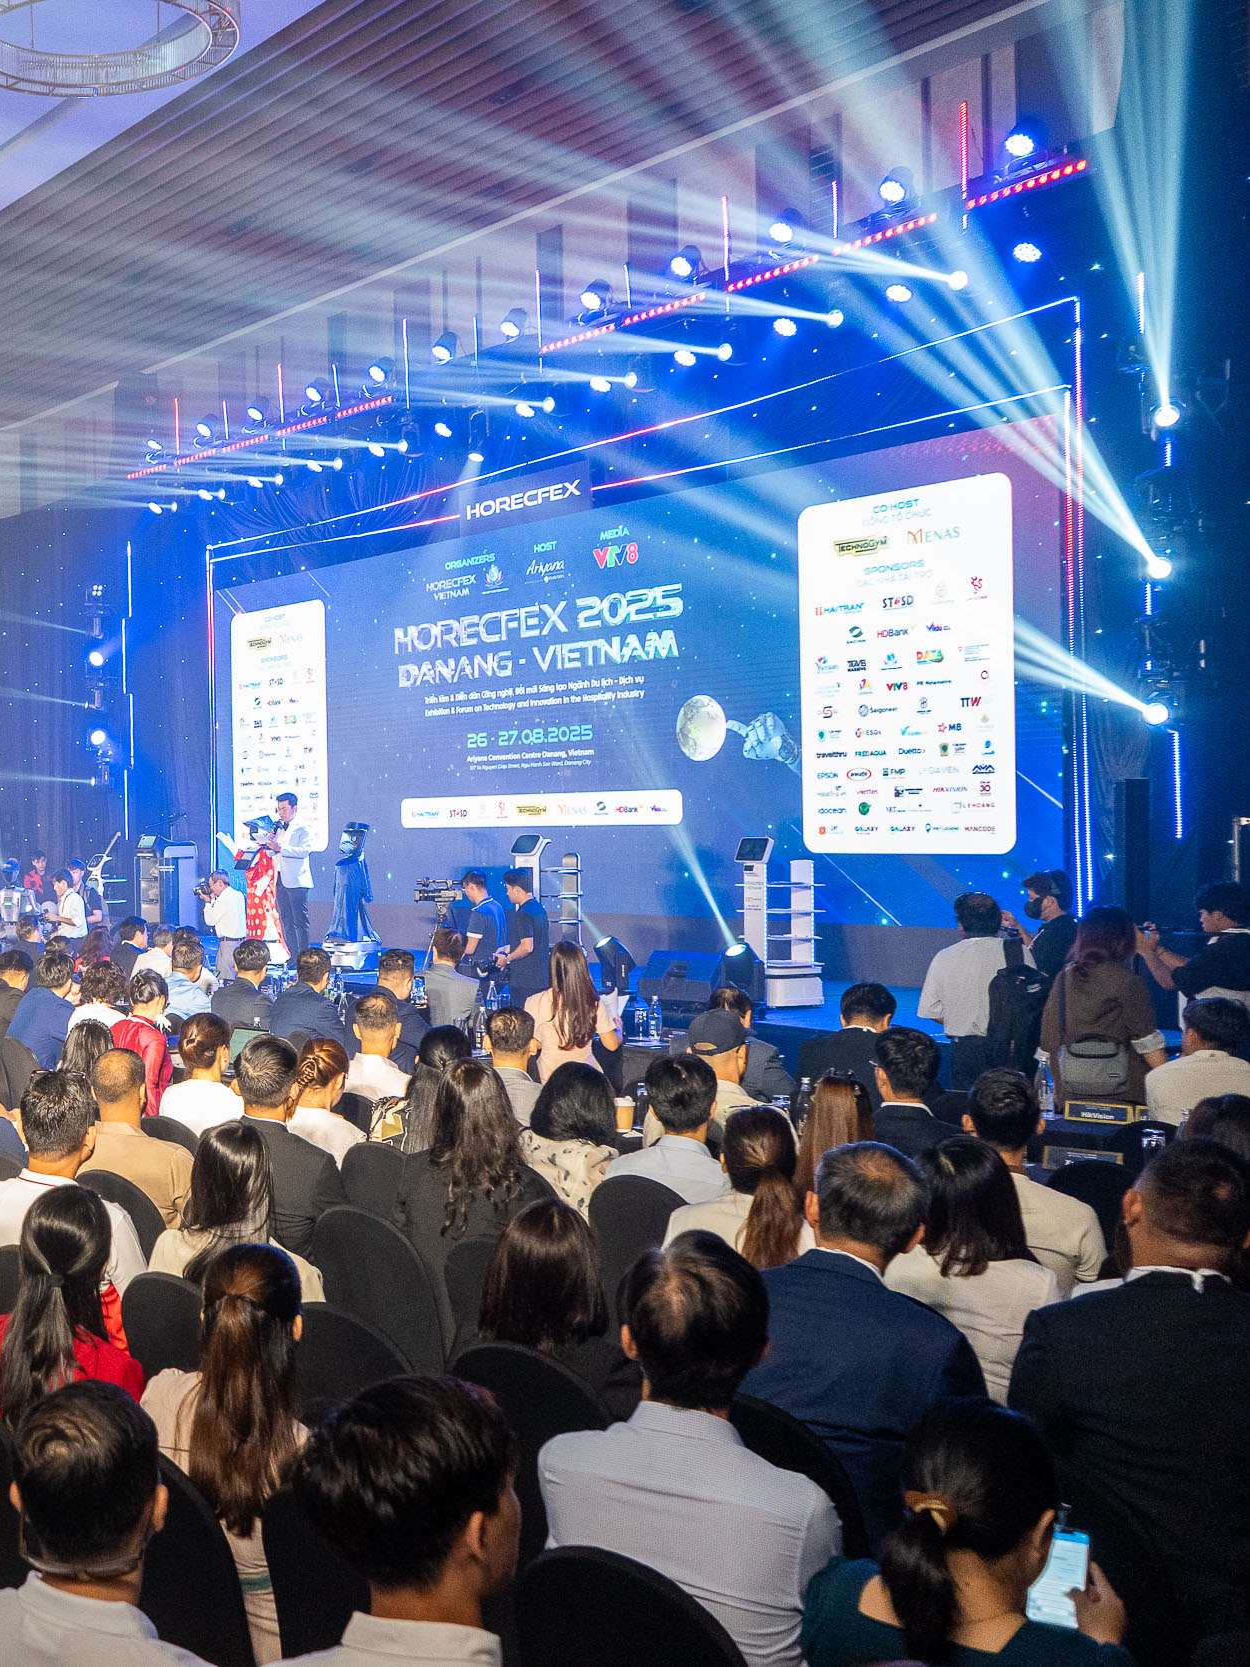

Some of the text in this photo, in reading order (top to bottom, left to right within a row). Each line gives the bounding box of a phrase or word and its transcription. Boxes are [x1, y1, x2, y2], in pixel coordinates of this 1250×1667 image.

[466, 480, 581, 520] HORECFEX
[600, 527, 629, 540] MEDIA
[533, 541, 557, 553] HOST
[593, 542, 638, 568] VTV8
[445, 553, 495, 570] ORGANIZERS
[526, 560, 565, 576] Ariyana
[864, 560, 925, 575] SPONSORS
[426, 574, 476, 592] HORECFEX
[433, 588, 470, 600] VIETNAM
[394, 584, 683, 655] HORECFEX 2025
[877, 628, 909, 638] HDBank
[398, 650, 513, 688] DANANG
[533, 630, 679, 672] VIETNAM
[591, 679, 600, 688] Du
[424, 707, 450, 717] Exhibition
[456, 705, 473, 714] Forum
[483, 701, 516, 711] Technology
[517, 699, 529, 708] and
[530, 697, 562, 707] Innovation
[563, 696, 569, 704] in
[570, 695, 581, 703] the
[582, 691, 616, 703] Hospitality
[617, 689, 645, 701] Industry
[467, 732, 488, 748] 26
[498, 724, 593, 746] 27.08.2025
[488, 752, 521, 761] Convention
[542, 750, 567, 759] Danang,
[568, 748, 594, 757] Vietnam
[1081, 1111, 1115, 1120] HikVision
